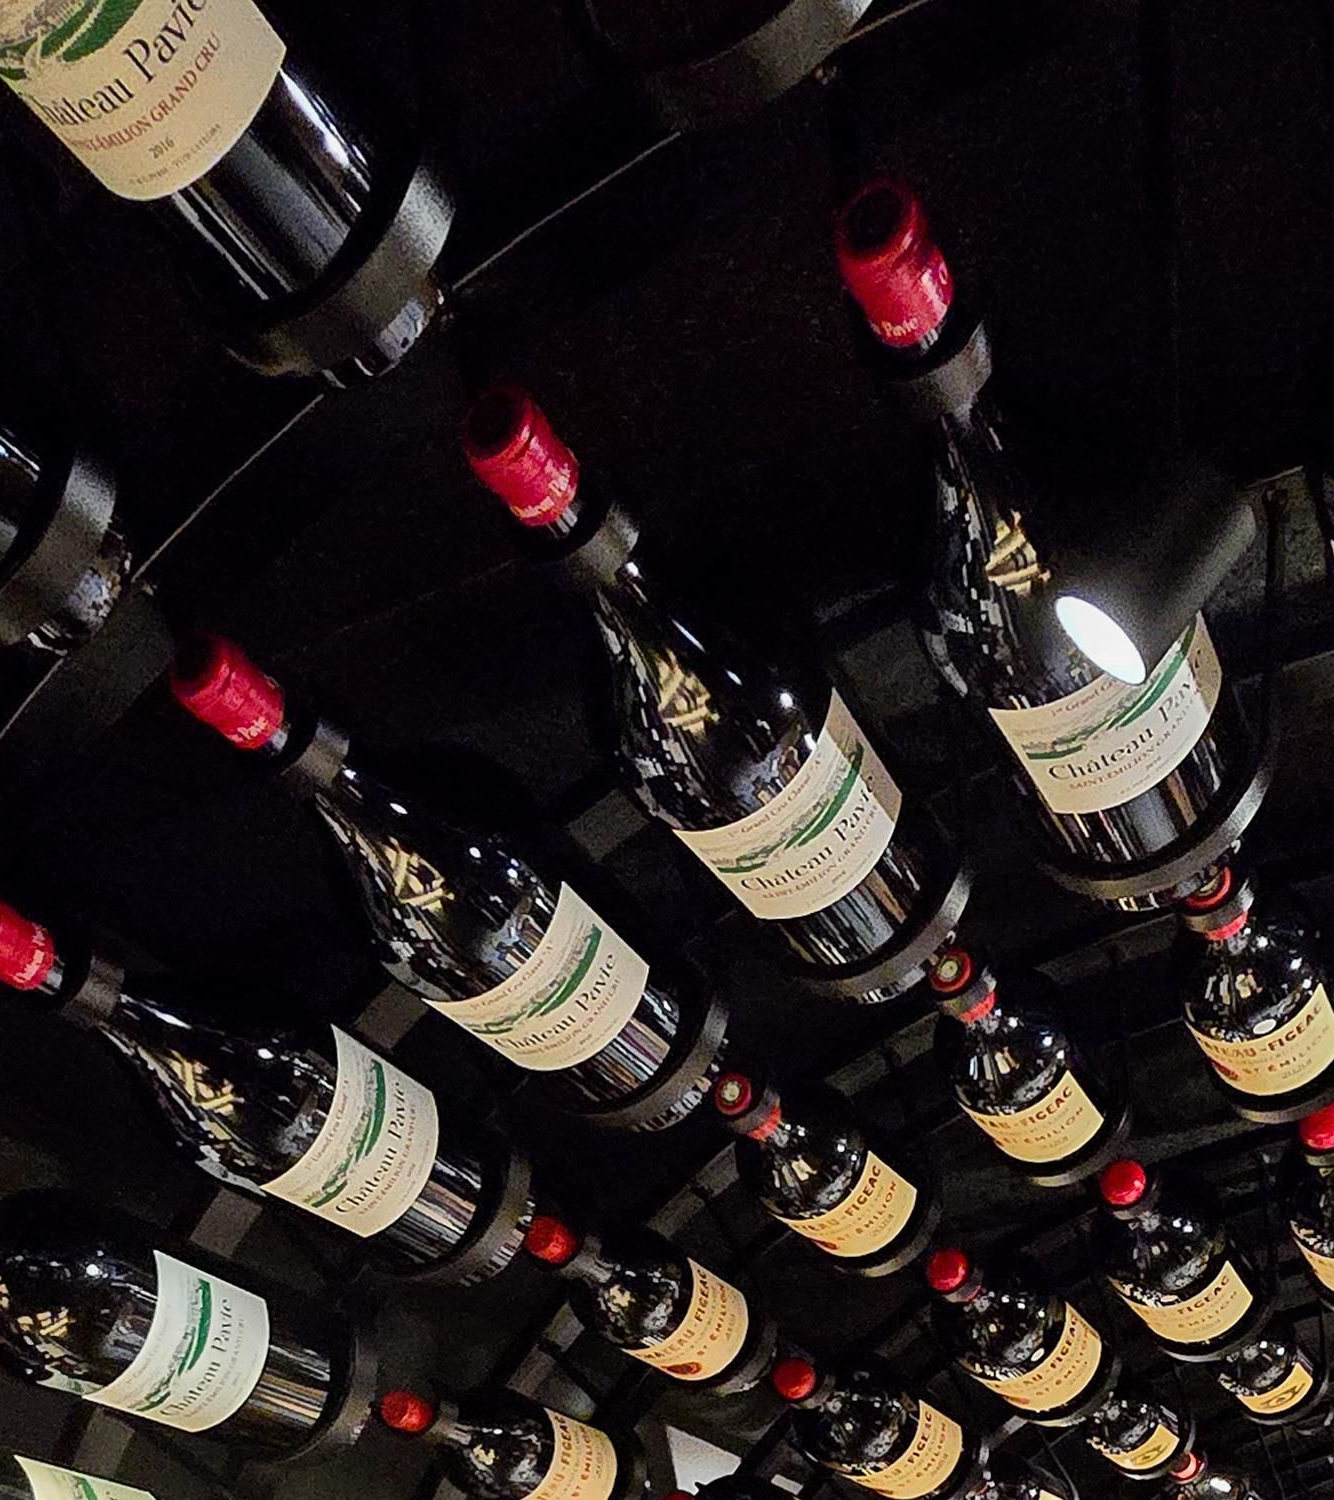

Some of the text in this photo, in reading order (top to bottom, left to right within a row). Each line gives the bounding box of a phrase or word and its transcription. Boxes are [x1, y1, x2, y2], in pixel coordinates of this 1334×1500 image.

[151, 31, 222, 124] GRAND CRU
[1048, 728, 1153, 781] Château
[740, 845, 834, 892] Château
[833, 776, 876, 841] Pavie
[575, 953, 617, 1012] Pavie
[334, 1082, 409, 1214] Château Pavie
[211, 1298, 234, 1353] Pavie
